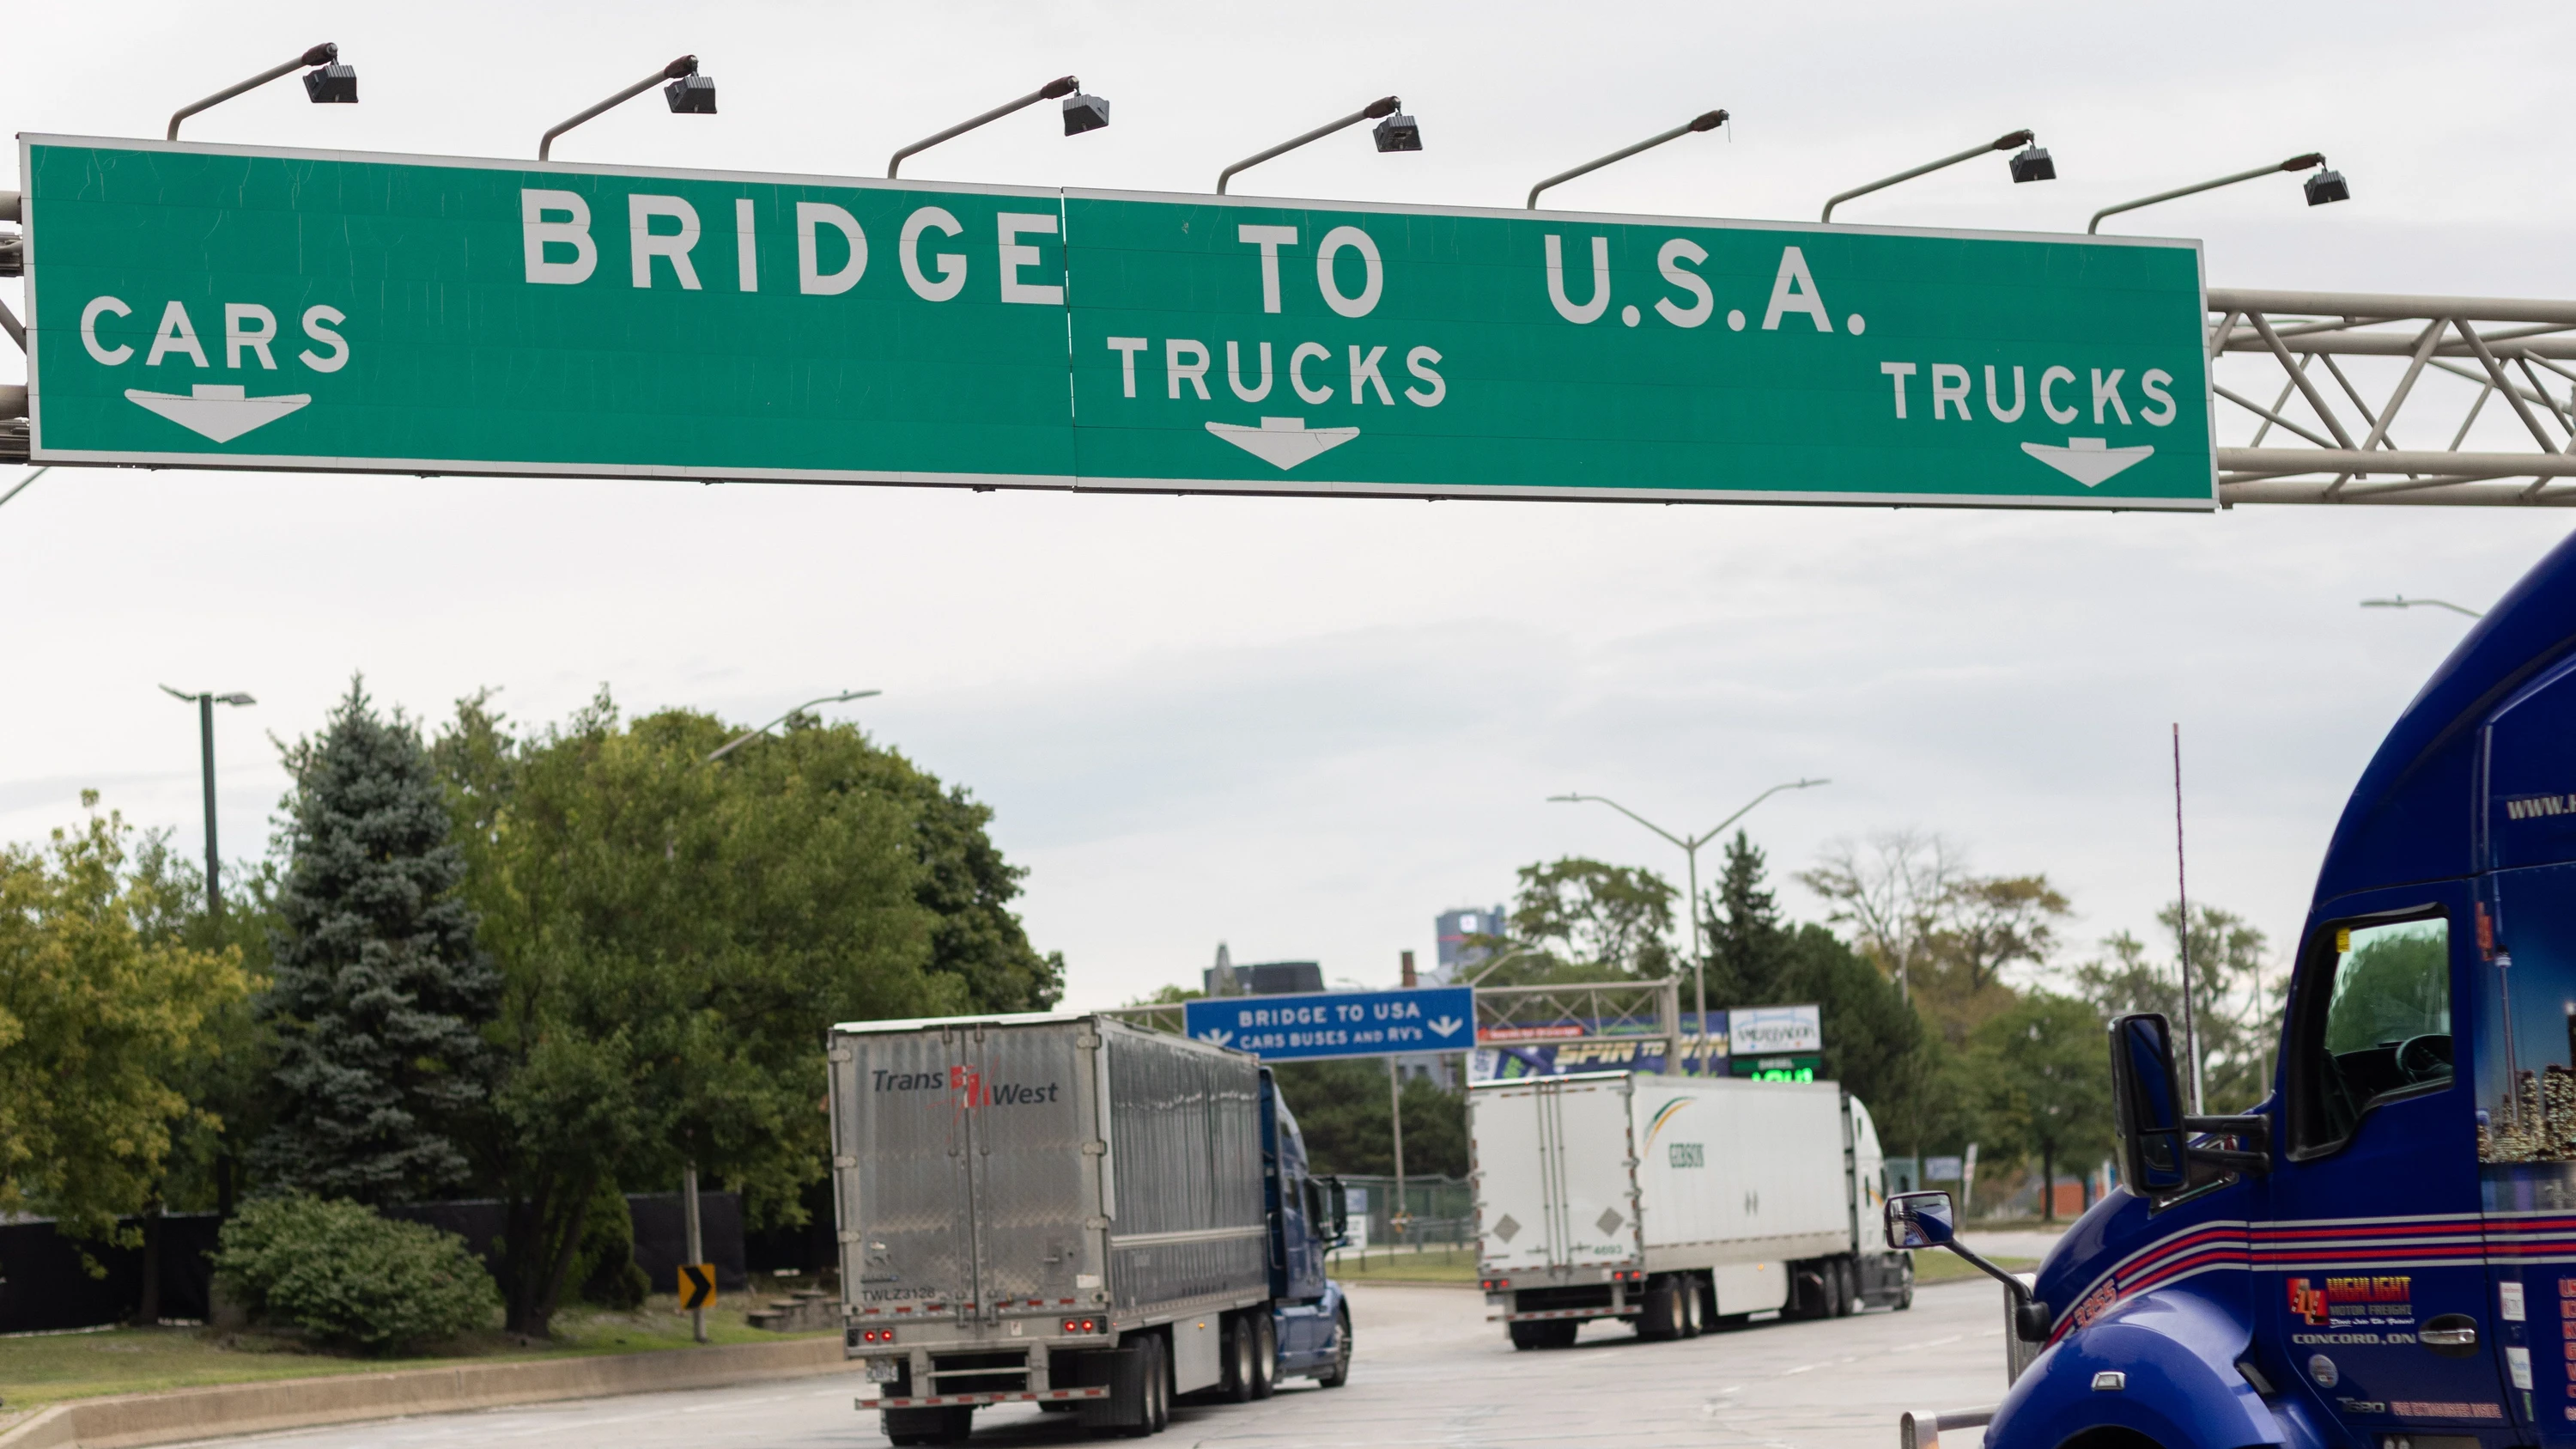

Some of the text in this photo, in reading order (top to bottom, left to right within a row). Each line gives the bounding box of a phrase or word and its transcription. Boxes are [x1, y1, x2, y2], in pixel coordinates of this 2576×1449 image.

[521, 188, 1866, 336] BRIDGE TO U.S.A.
[81, 295, 349, 373] CARS
[1107, 337, 1446, 407] TRUCKS
[1880, 362, 2178, 427] TRUCKS
[1238, 1002, 1422, 1028] BRIDGE TO USA
[1239, 1032, 1285, 1050] CARS
[1290, 1031, 1348, 1048] BUSES
[1352, 1031, 1384, 1044] AND
[1554, 1042, 1637, 1066] SPIN
[1641, 1041, 1666, 1057] TO
[872, 1069, 1059, 1105] Trans West
[2326, 1276, 2411, 1301] HIGHLIGHT
